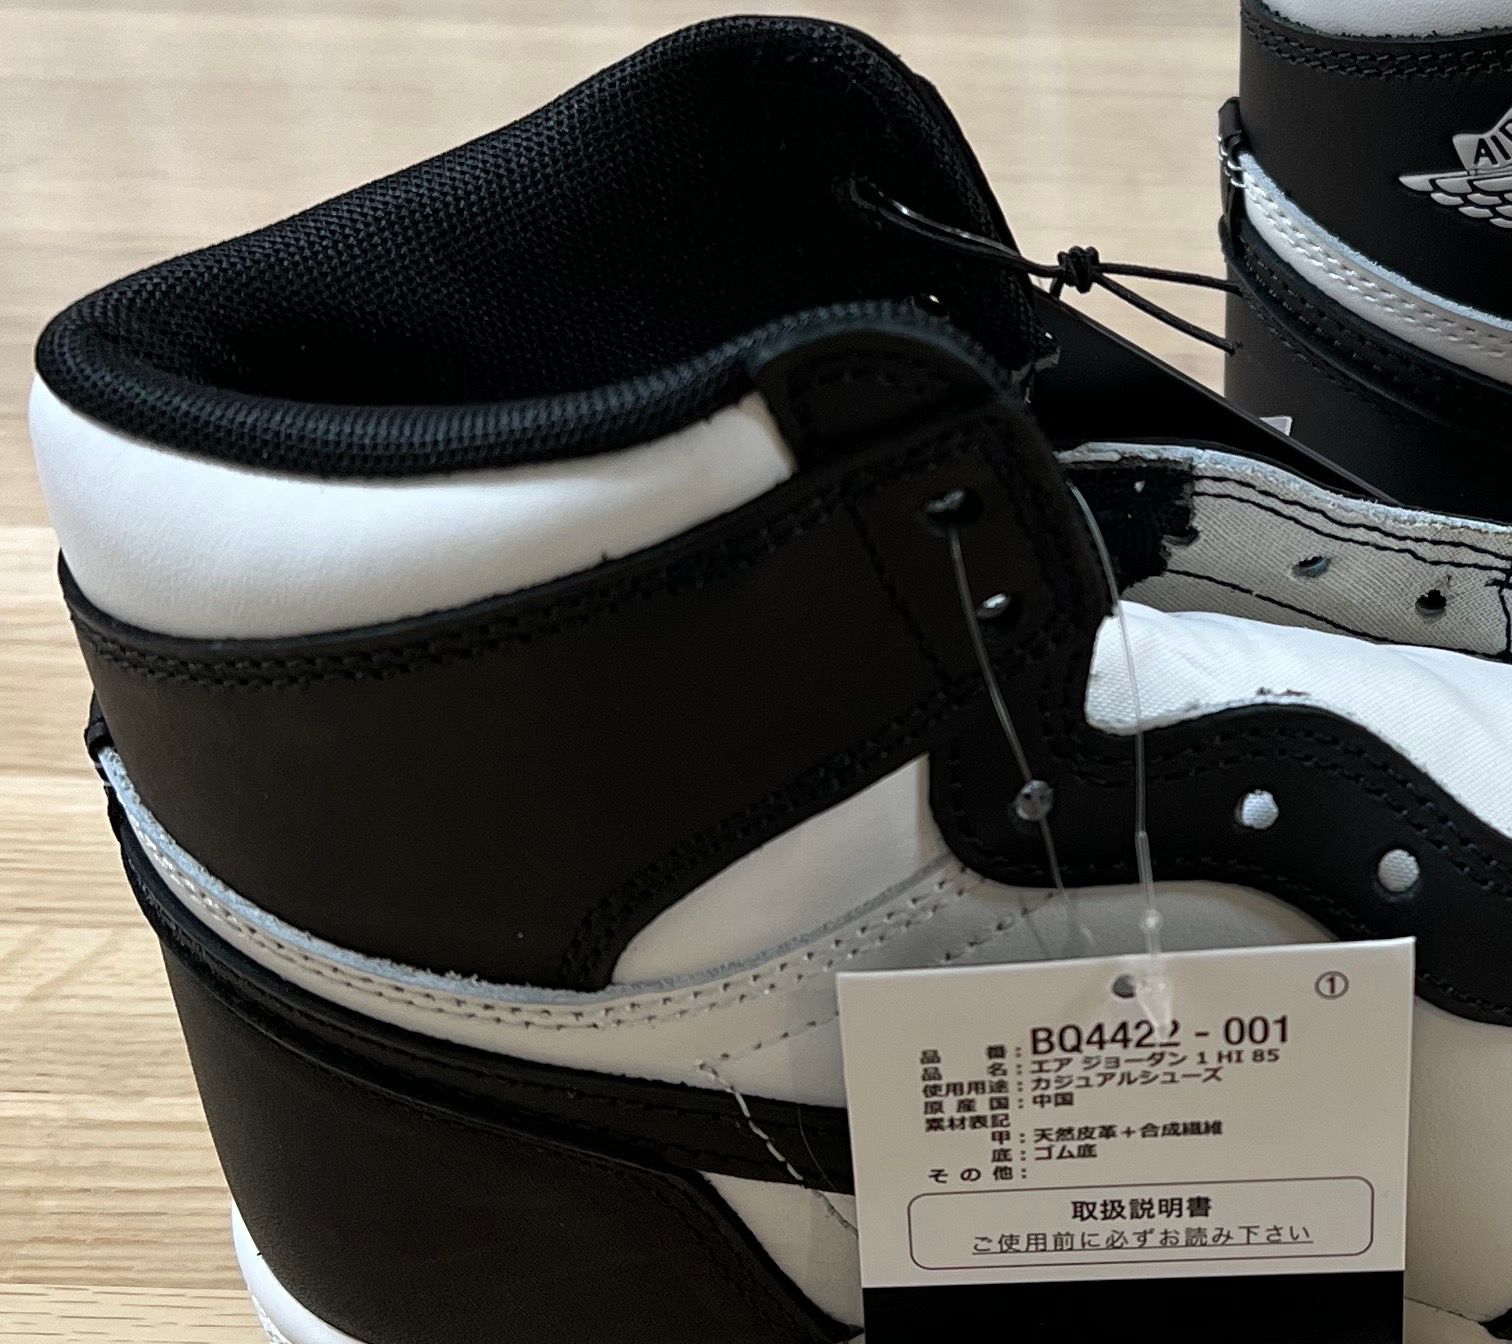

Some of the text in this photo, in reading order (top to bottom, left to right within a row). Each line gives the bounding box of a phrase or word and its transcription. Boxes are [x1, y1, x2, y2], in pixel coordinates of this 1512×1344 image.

[1224, 1015, 1290, 1046] 001
[1032, 1092, 1075, 1108] 中国
[1034, 1144, 1098, 1161] ゴム底
[1071, 1195, 1212, 1222] 取扱説明書
[972, 1224, 1311, 1254] ご使用前に必ずお読み下さい
